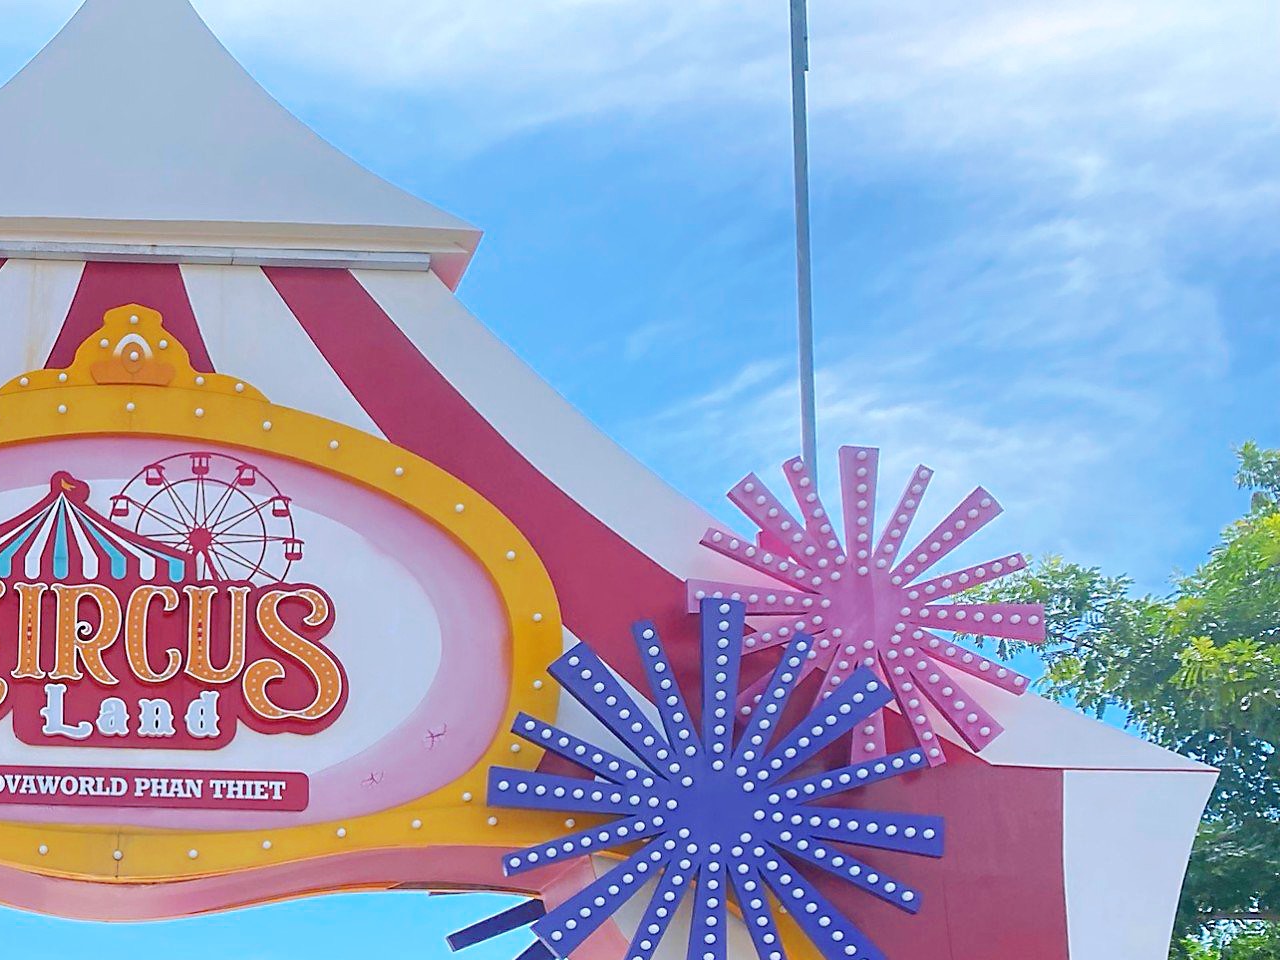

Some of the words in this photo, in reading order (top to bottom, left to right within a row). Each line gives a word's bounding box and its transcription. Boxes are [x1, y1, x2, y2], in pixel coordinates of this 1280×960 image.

[39, 683, 222, 740] Land
[134, 778, 204, 799] PHAN
[210, 780, 286, 801] THIET
